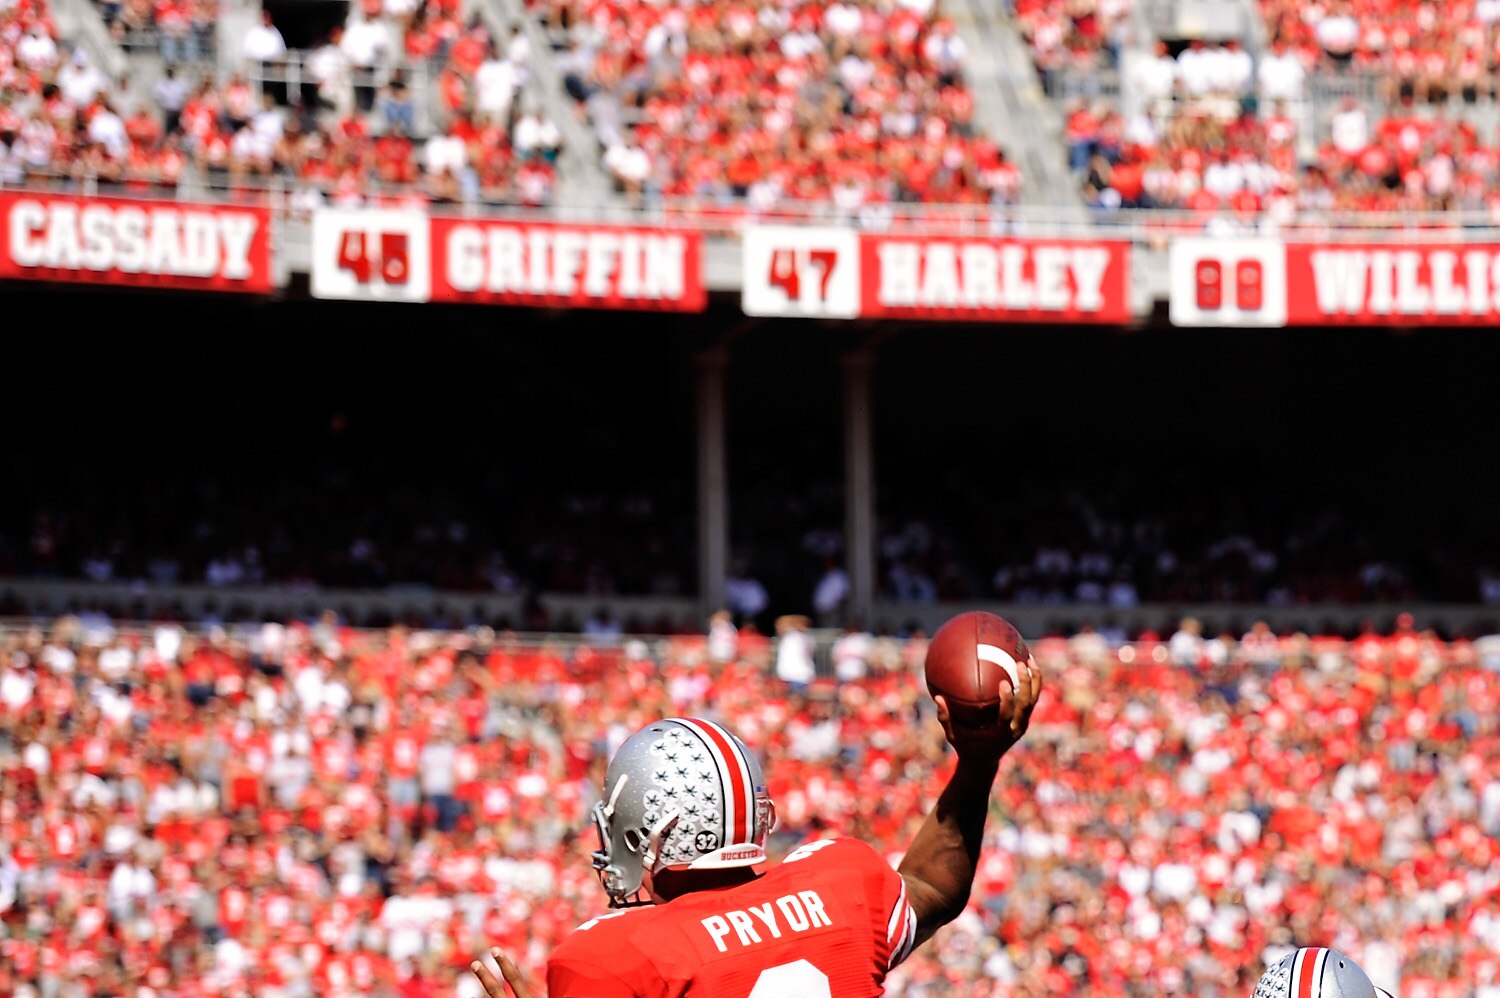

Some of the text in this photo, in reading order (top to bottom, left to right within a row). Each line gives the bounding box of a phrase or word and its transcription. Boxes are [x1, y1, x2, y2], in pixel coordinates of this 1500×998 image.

[9, 202, 260, 280] CASSADY
[445, 224, 687, 299] GRIFFIN
[767, 246, 838, 304] 47
[876, 242, 1111, 313] HARLEY
[695, 832, 718, 851] 32
[701, 890, 832, 952] PRYOR
